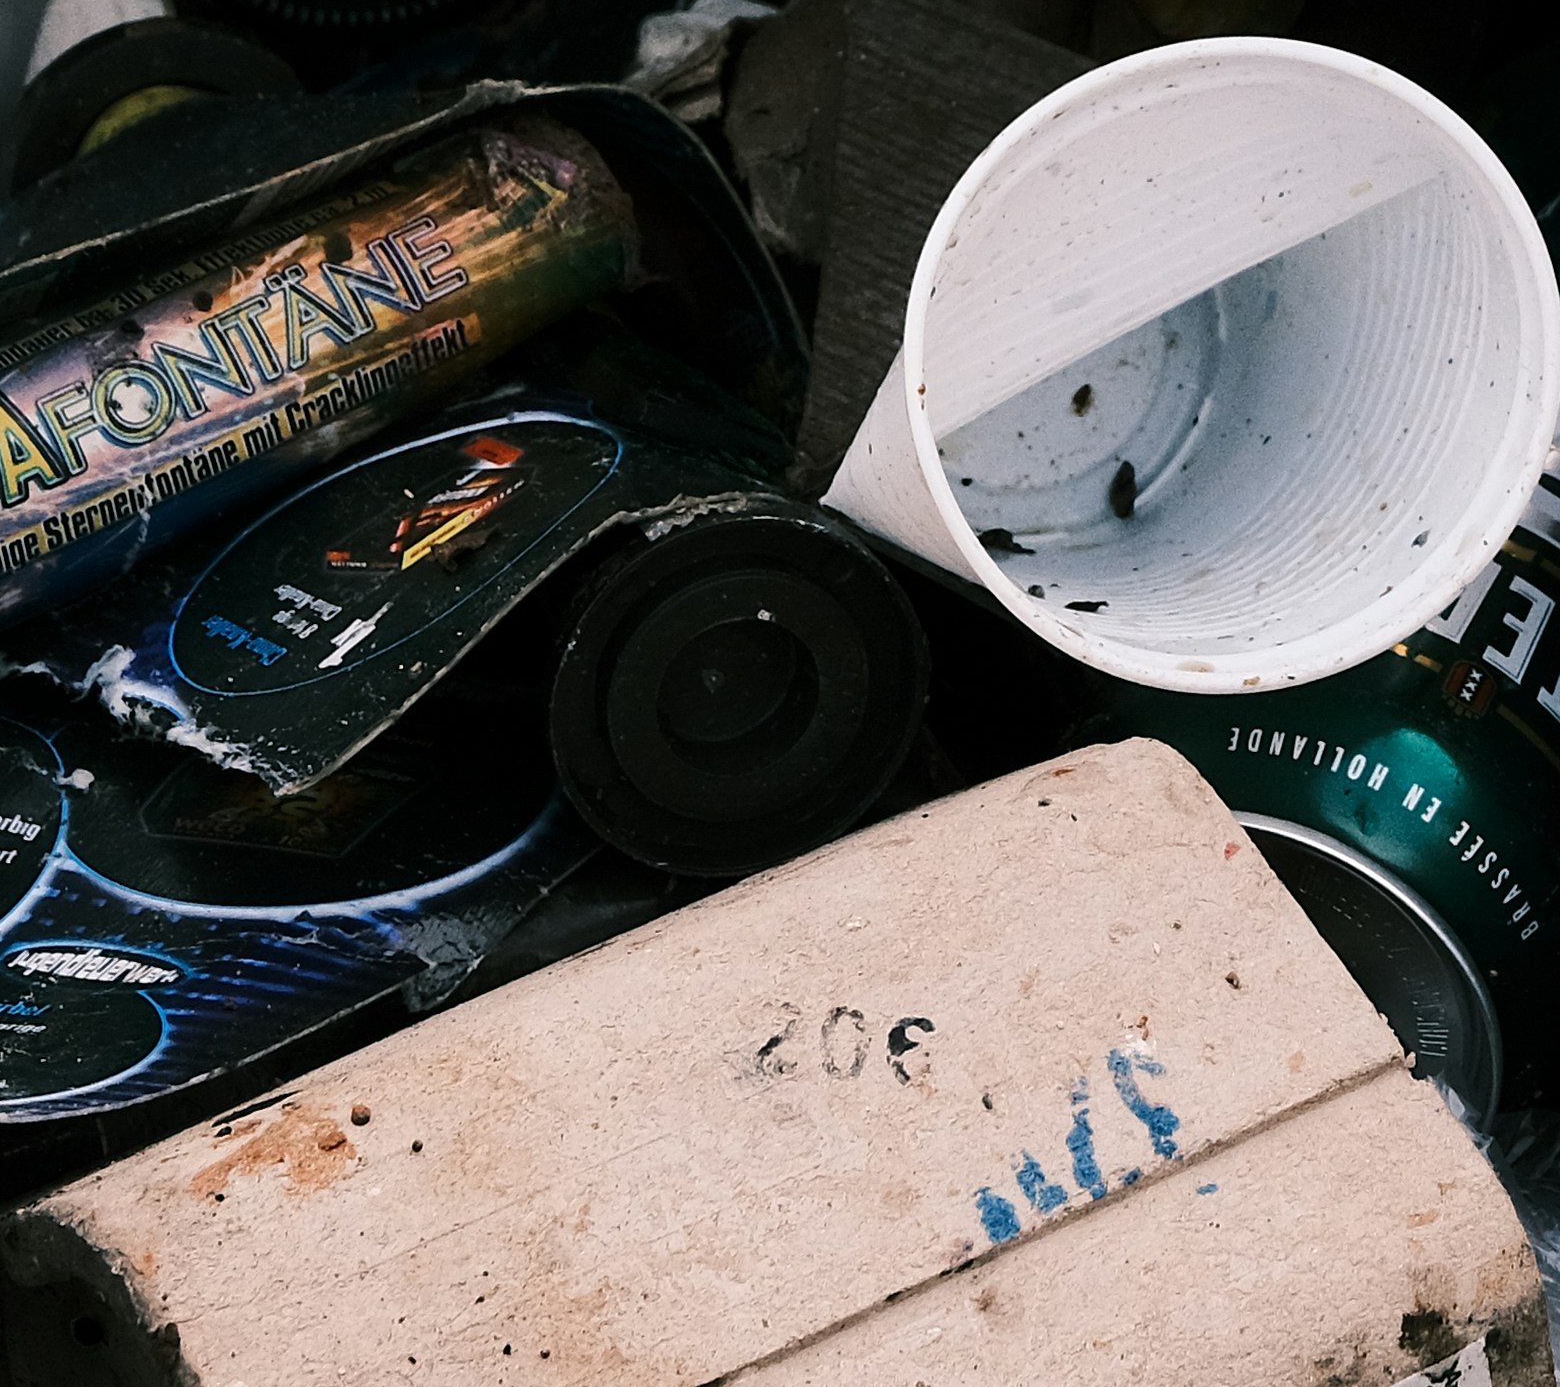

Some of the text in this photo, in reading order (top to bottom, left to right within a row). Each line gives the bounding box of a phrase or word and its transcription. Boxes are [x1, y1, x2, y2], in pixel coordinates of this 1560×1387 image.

[237, 408, 286, 455] mit
[280, 315, 472, 437] Cracklingeffekt
[1221, 722, 1538, 942] BRASSÉE EN HOLLANDE
